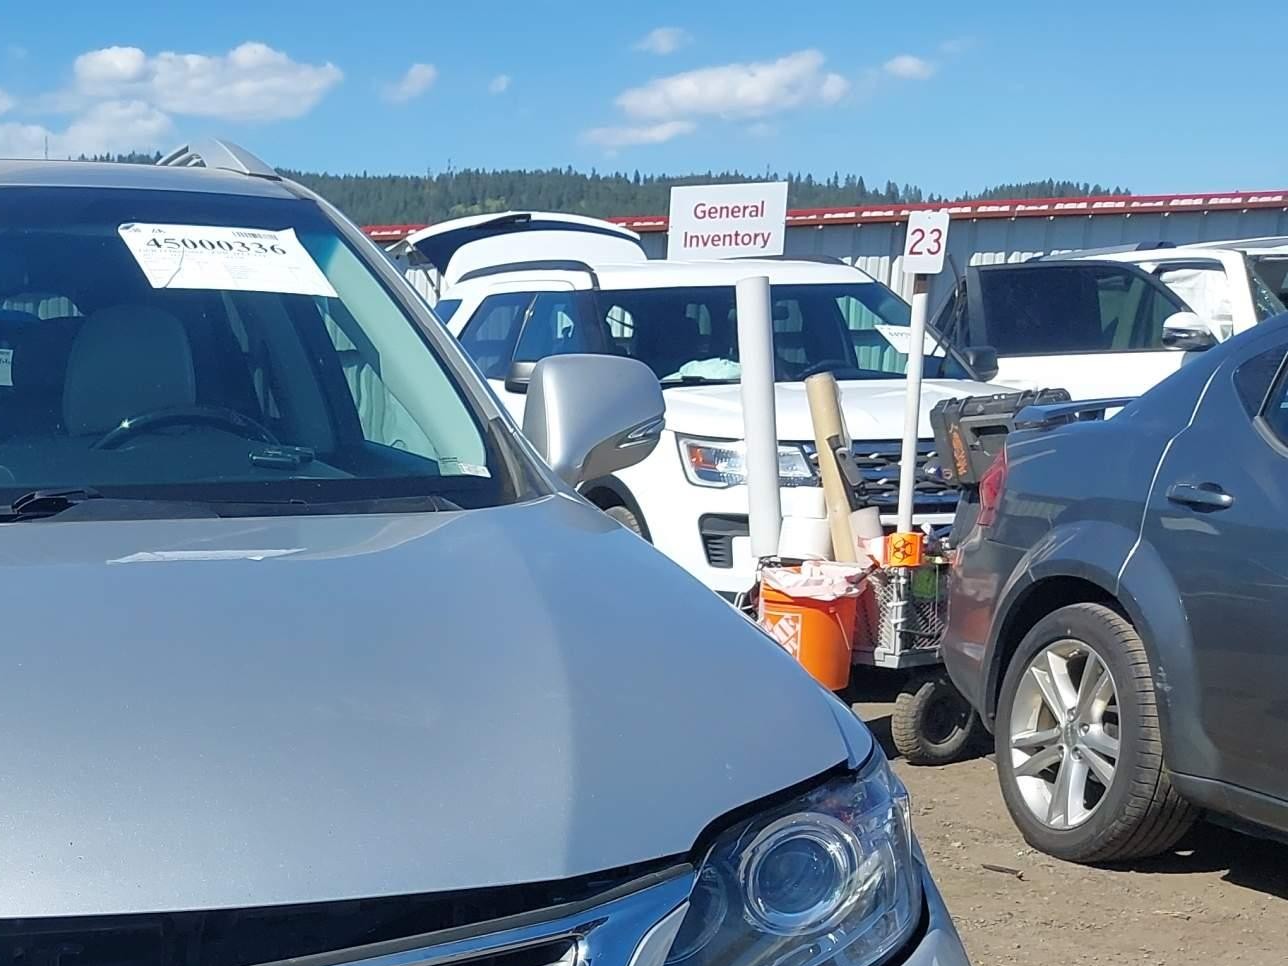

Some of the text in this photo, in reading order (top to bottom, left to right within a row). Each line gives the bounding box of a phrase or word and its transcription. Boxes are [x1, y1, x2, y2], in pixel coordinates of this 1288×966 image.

[694, 200, 765, 219] General
[145, 237, 287, 255] 45000336
[683, 230, 772, 248] Inventory
[909, 228, 942, 255] 23
